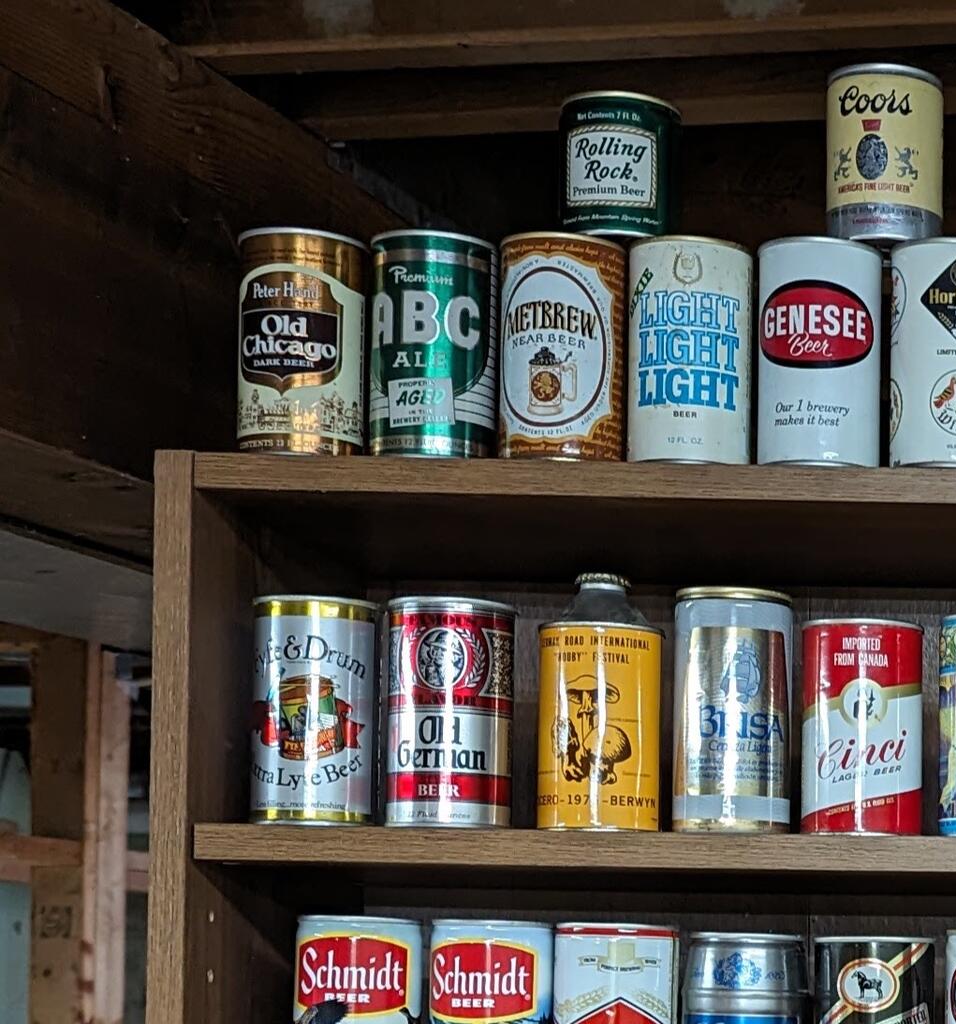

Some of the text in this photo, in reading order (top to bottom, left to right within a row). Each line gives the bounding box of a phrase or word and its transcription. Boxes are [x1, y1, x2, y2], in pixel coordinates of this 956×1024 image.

[838, 86, 912, 116] Coors
[575, 138, 648, 161] Rolling
[585, 160, 633, 182] Rock
[573, 184, 645, 198] Premium Beer
[253, 282, 280, 299] Peter
[372, 290, 480, 350] ABC
[507, 300, 597, 340] METBREW
[639, 290, 740, 334] LIGHT
[764, 304, 866, 341] GENESEE
[261, 314, 308, 337] Old
[242, 336, 337, 361] Chicago
[639, 328, 739, 373] LIGHT
[788, 331, 832, 356] Beer
[392, 351, 447, 369] ALE
[638, 368, 739, 412] LIGHT
[775, 400, 850, 416] Our brewery
[774, 415, 840, 427] makes best
[565, 635, 650, 651] ROAD INTERNATIONAL
[842, 637, 881, 651] IMPORTED
[834, 652, 888, 668] FROM CANADA
[610, 795, 656, 808] BERWYN
[301, 947, 403, 995] Schmidt
[433, 953, 530, 1000] Schmidt
[451, 998, 495, 1008] BEER
